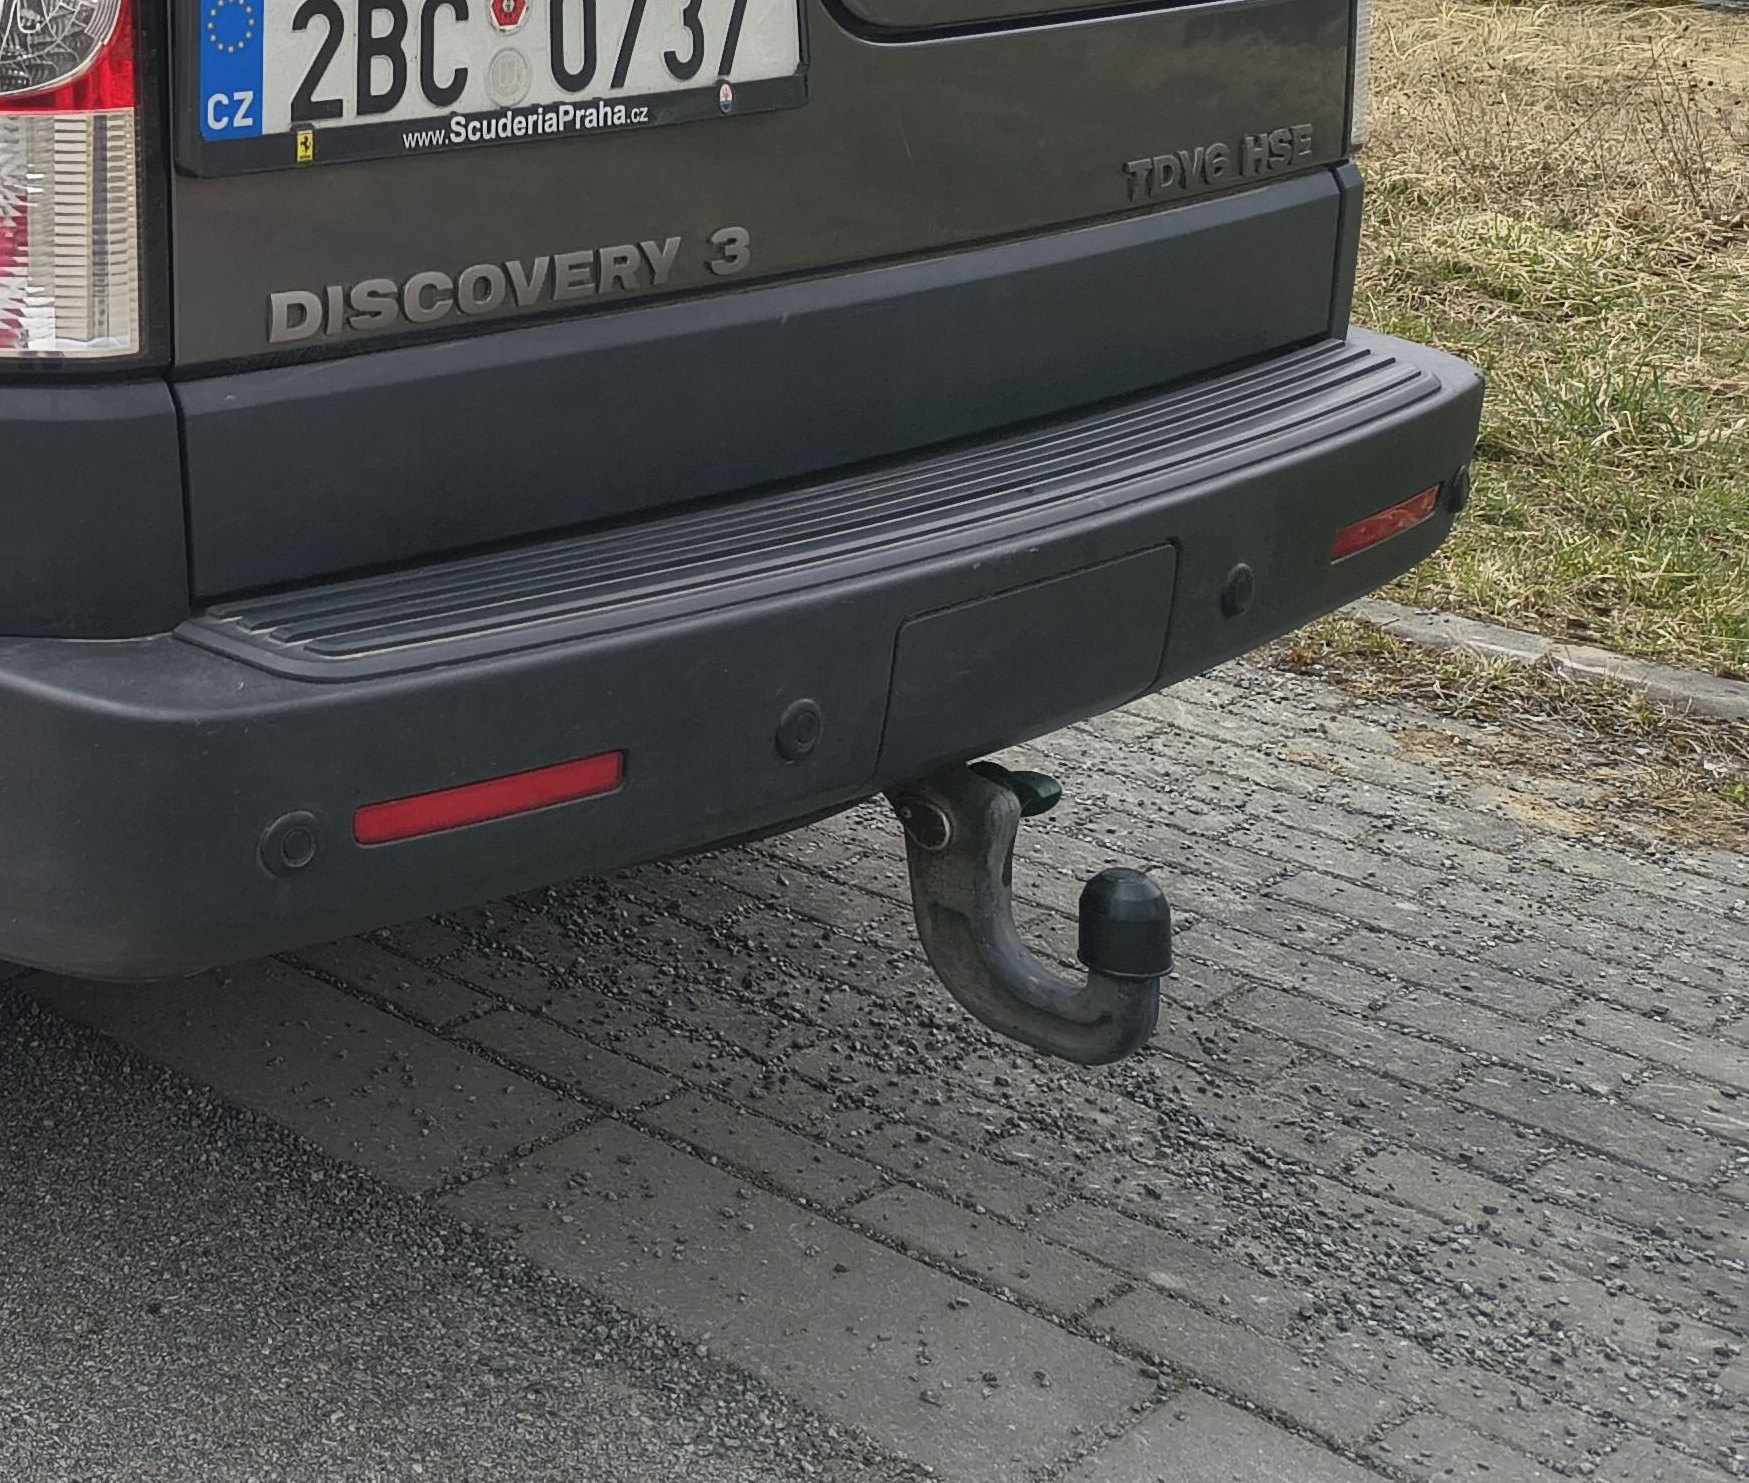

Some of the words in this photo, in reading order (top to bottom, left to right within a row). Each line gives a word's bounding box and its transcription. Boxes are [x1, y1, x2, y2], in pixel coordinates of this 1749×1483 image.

[206, 90, 254, 131] CZ
[402, 103, 649, 149] www.ScuderiaPraha.cz
[1123, 143, 1230, 202] TDV6
[1241, 123, 1313, 178] HSE
[268, 236, 682, 343] DISCOVERY
[707, 226, 751, 276] 3
